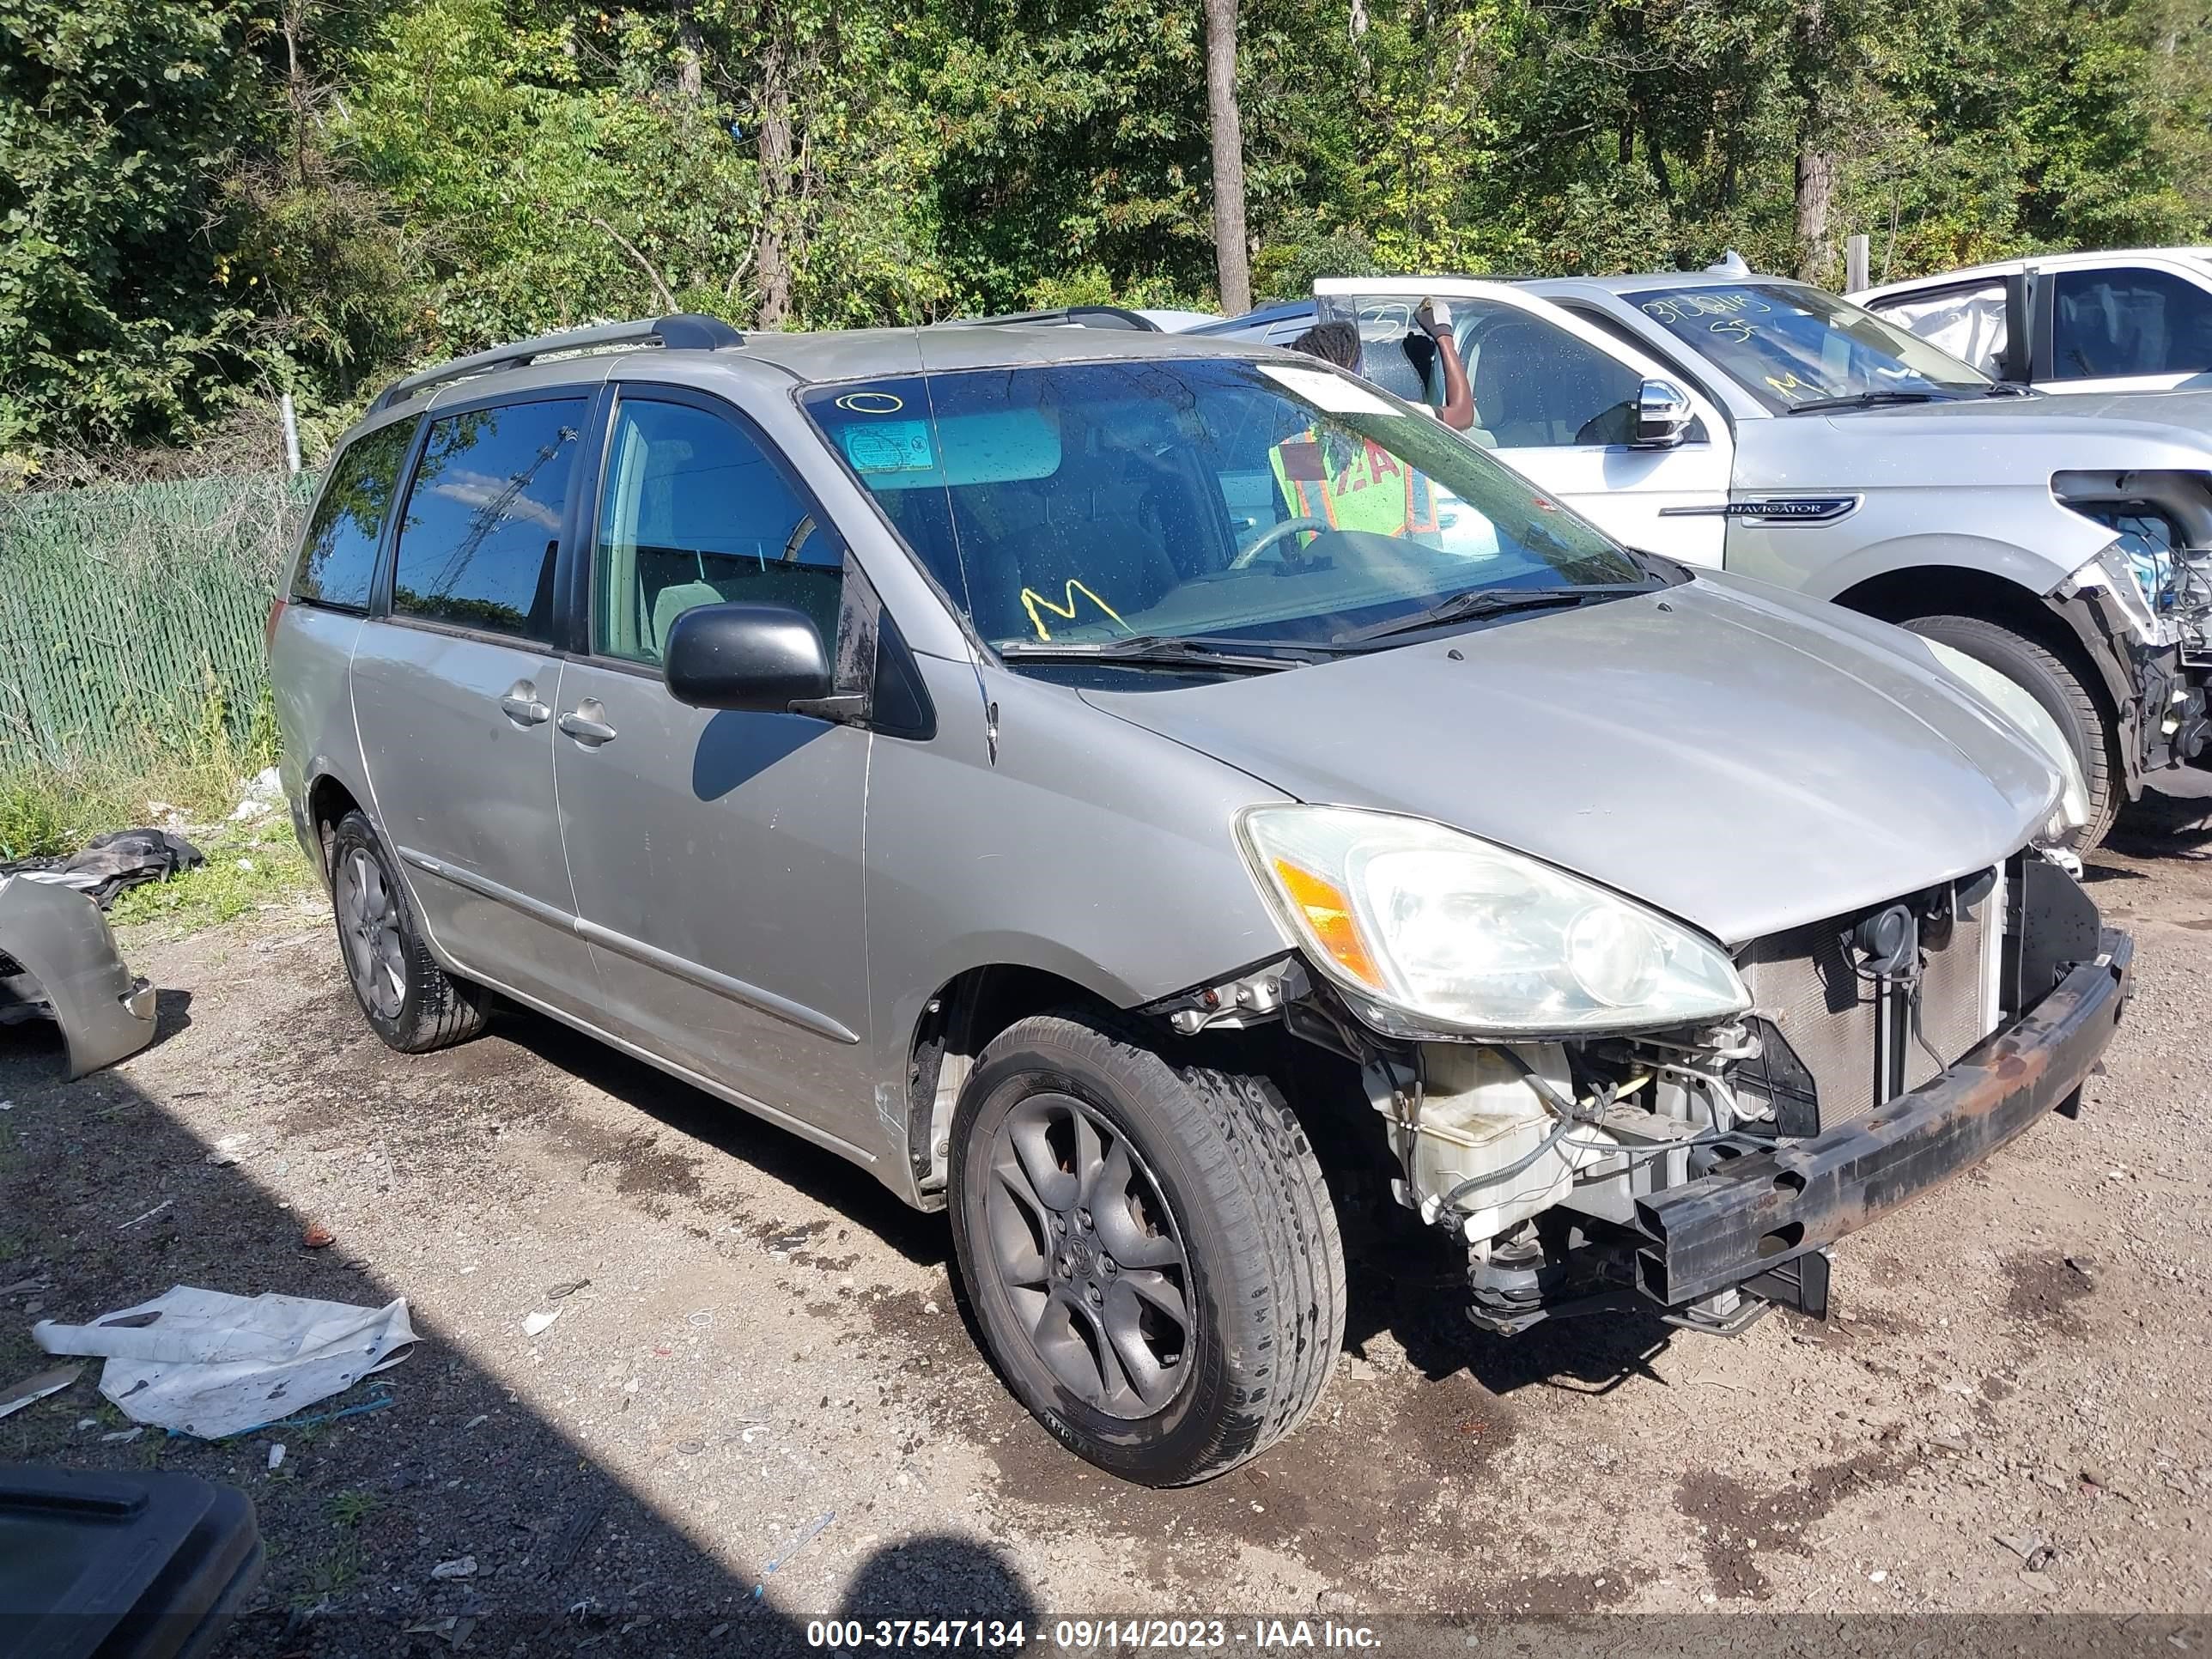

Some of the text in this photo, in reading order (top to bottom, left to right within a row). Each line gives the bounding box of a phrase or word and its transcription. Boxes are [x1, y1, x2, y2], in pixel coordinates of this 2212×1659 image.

[1765, 372, 1829, 401] M
[1730, 504, 1821, 514] NAVIGATOR
[1020, 579, 1137, 641] M
